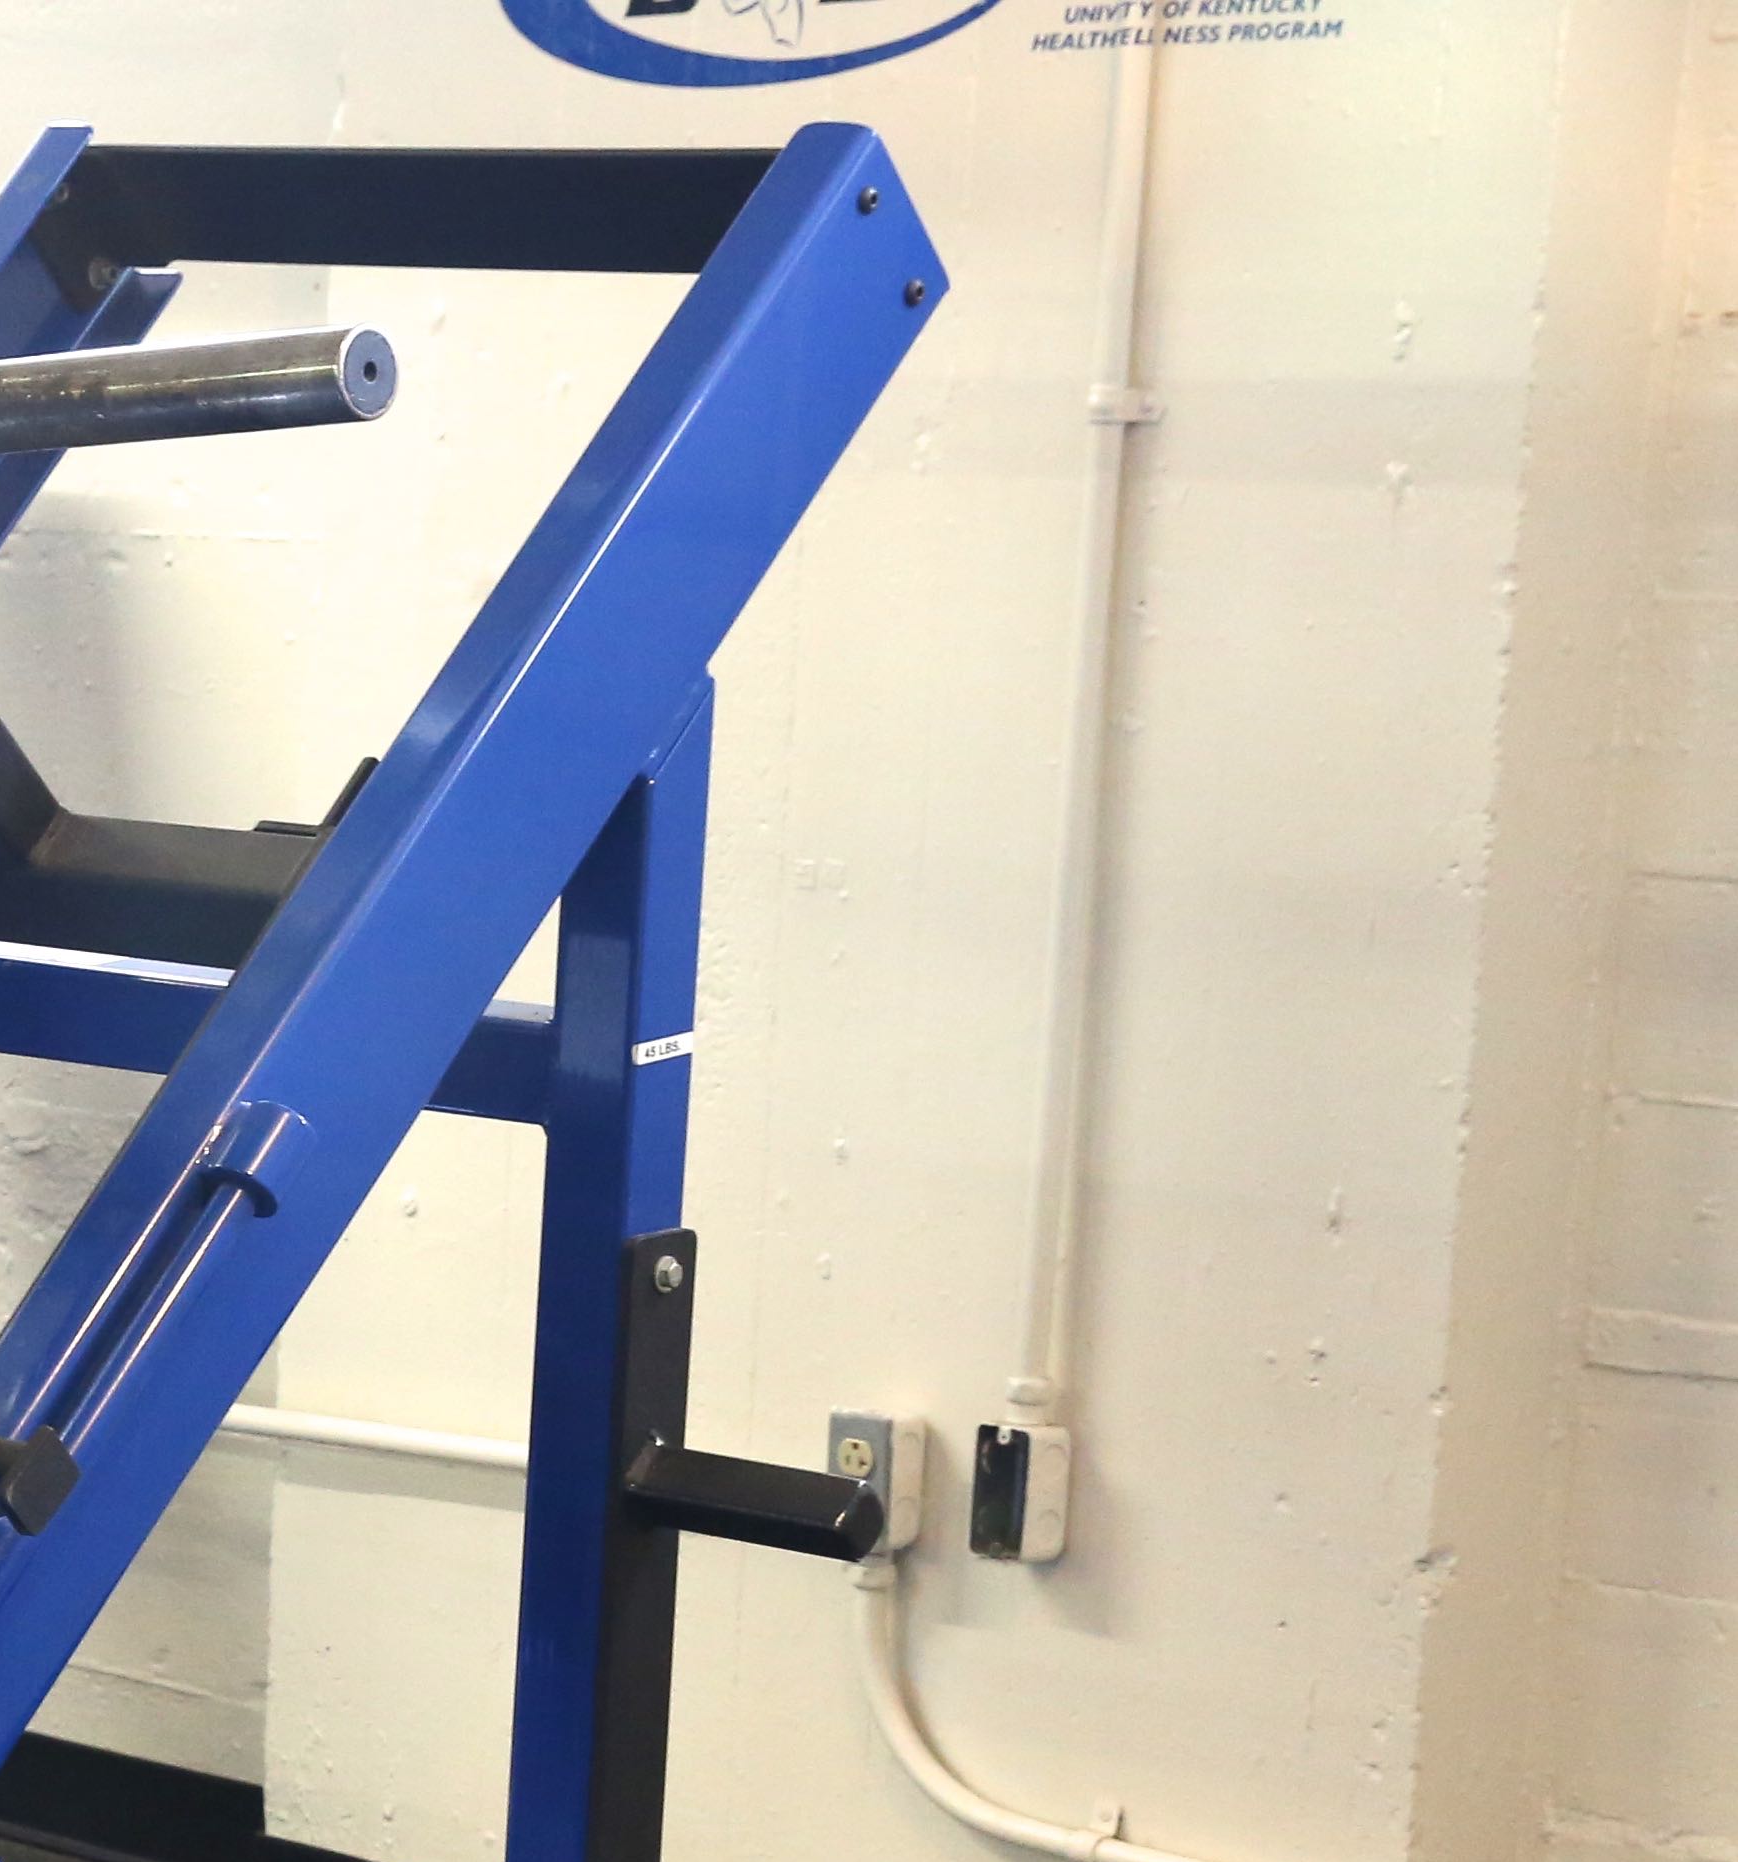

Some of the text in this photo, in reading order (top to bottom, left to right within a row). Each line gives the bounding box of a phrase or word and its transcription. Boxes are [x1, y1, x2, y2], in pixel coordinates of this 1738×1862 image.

[1162, 1, 1191, 18] OF
[1228, 18, 1344, 41] PROGRAM
[644, 1045, 656, 1058] 45
